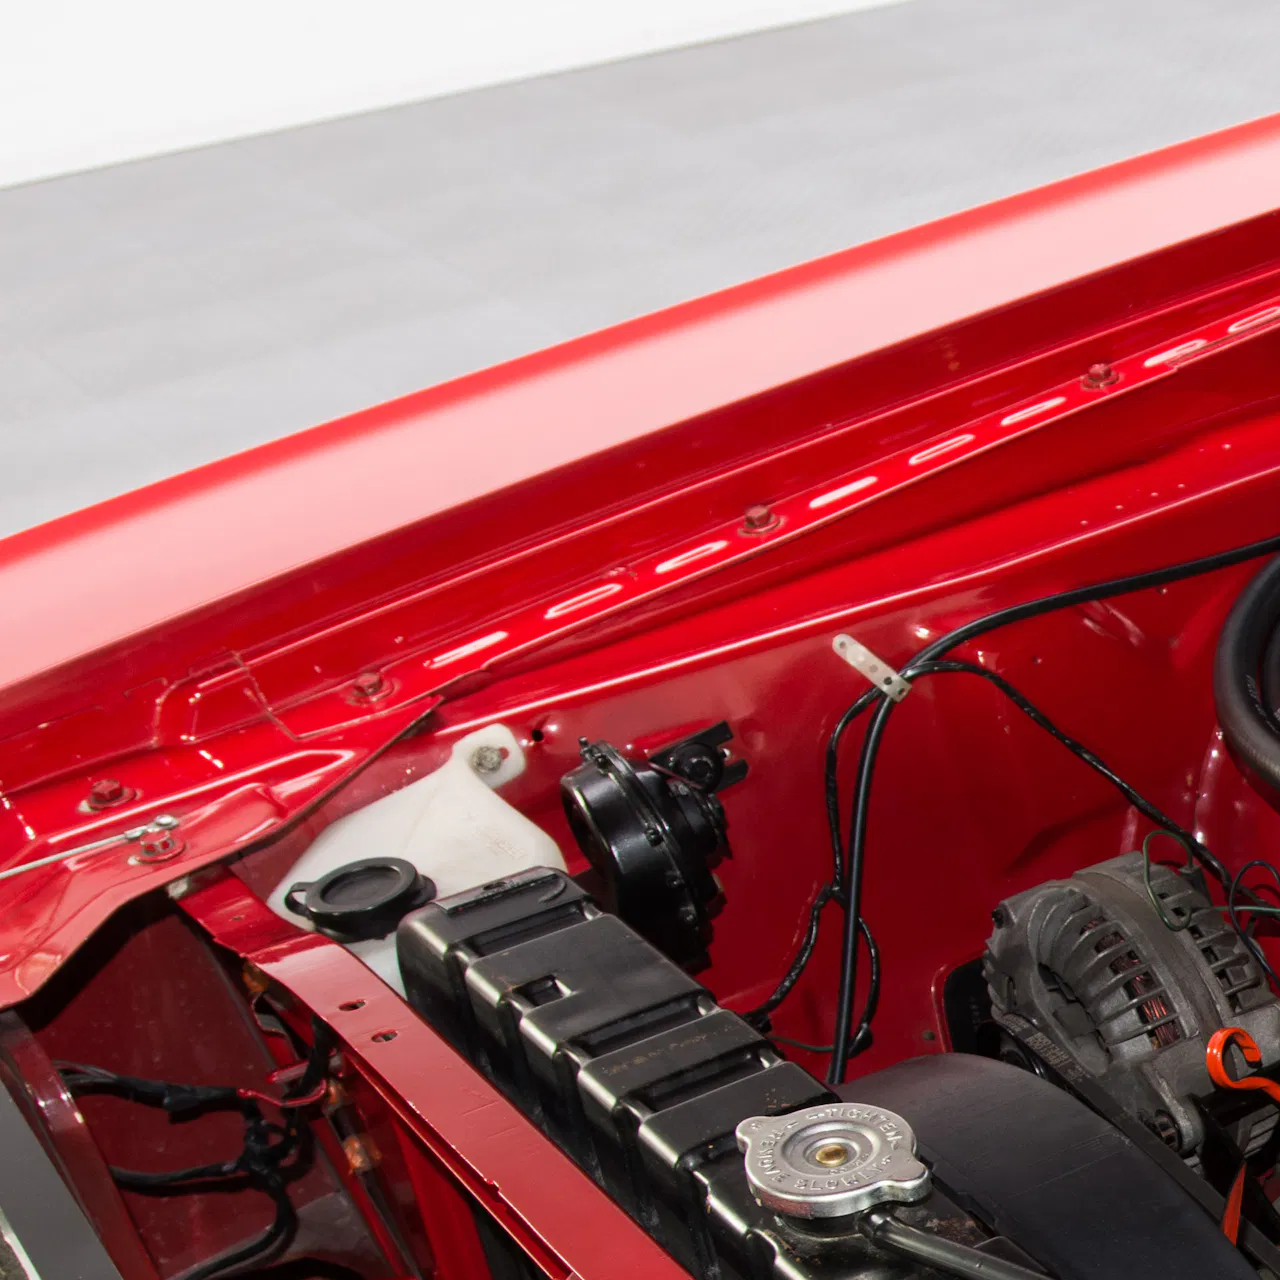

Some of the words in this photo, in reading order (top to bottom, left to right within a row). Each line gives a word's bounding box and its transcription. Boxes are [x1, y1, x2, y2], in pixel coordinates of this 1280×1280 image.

[825, 1108, 903, 1150] TIGHTEN
[757, 1129, 790, 1183] REMOVE
[794, 1163, 883, 1191] SLOWLY
